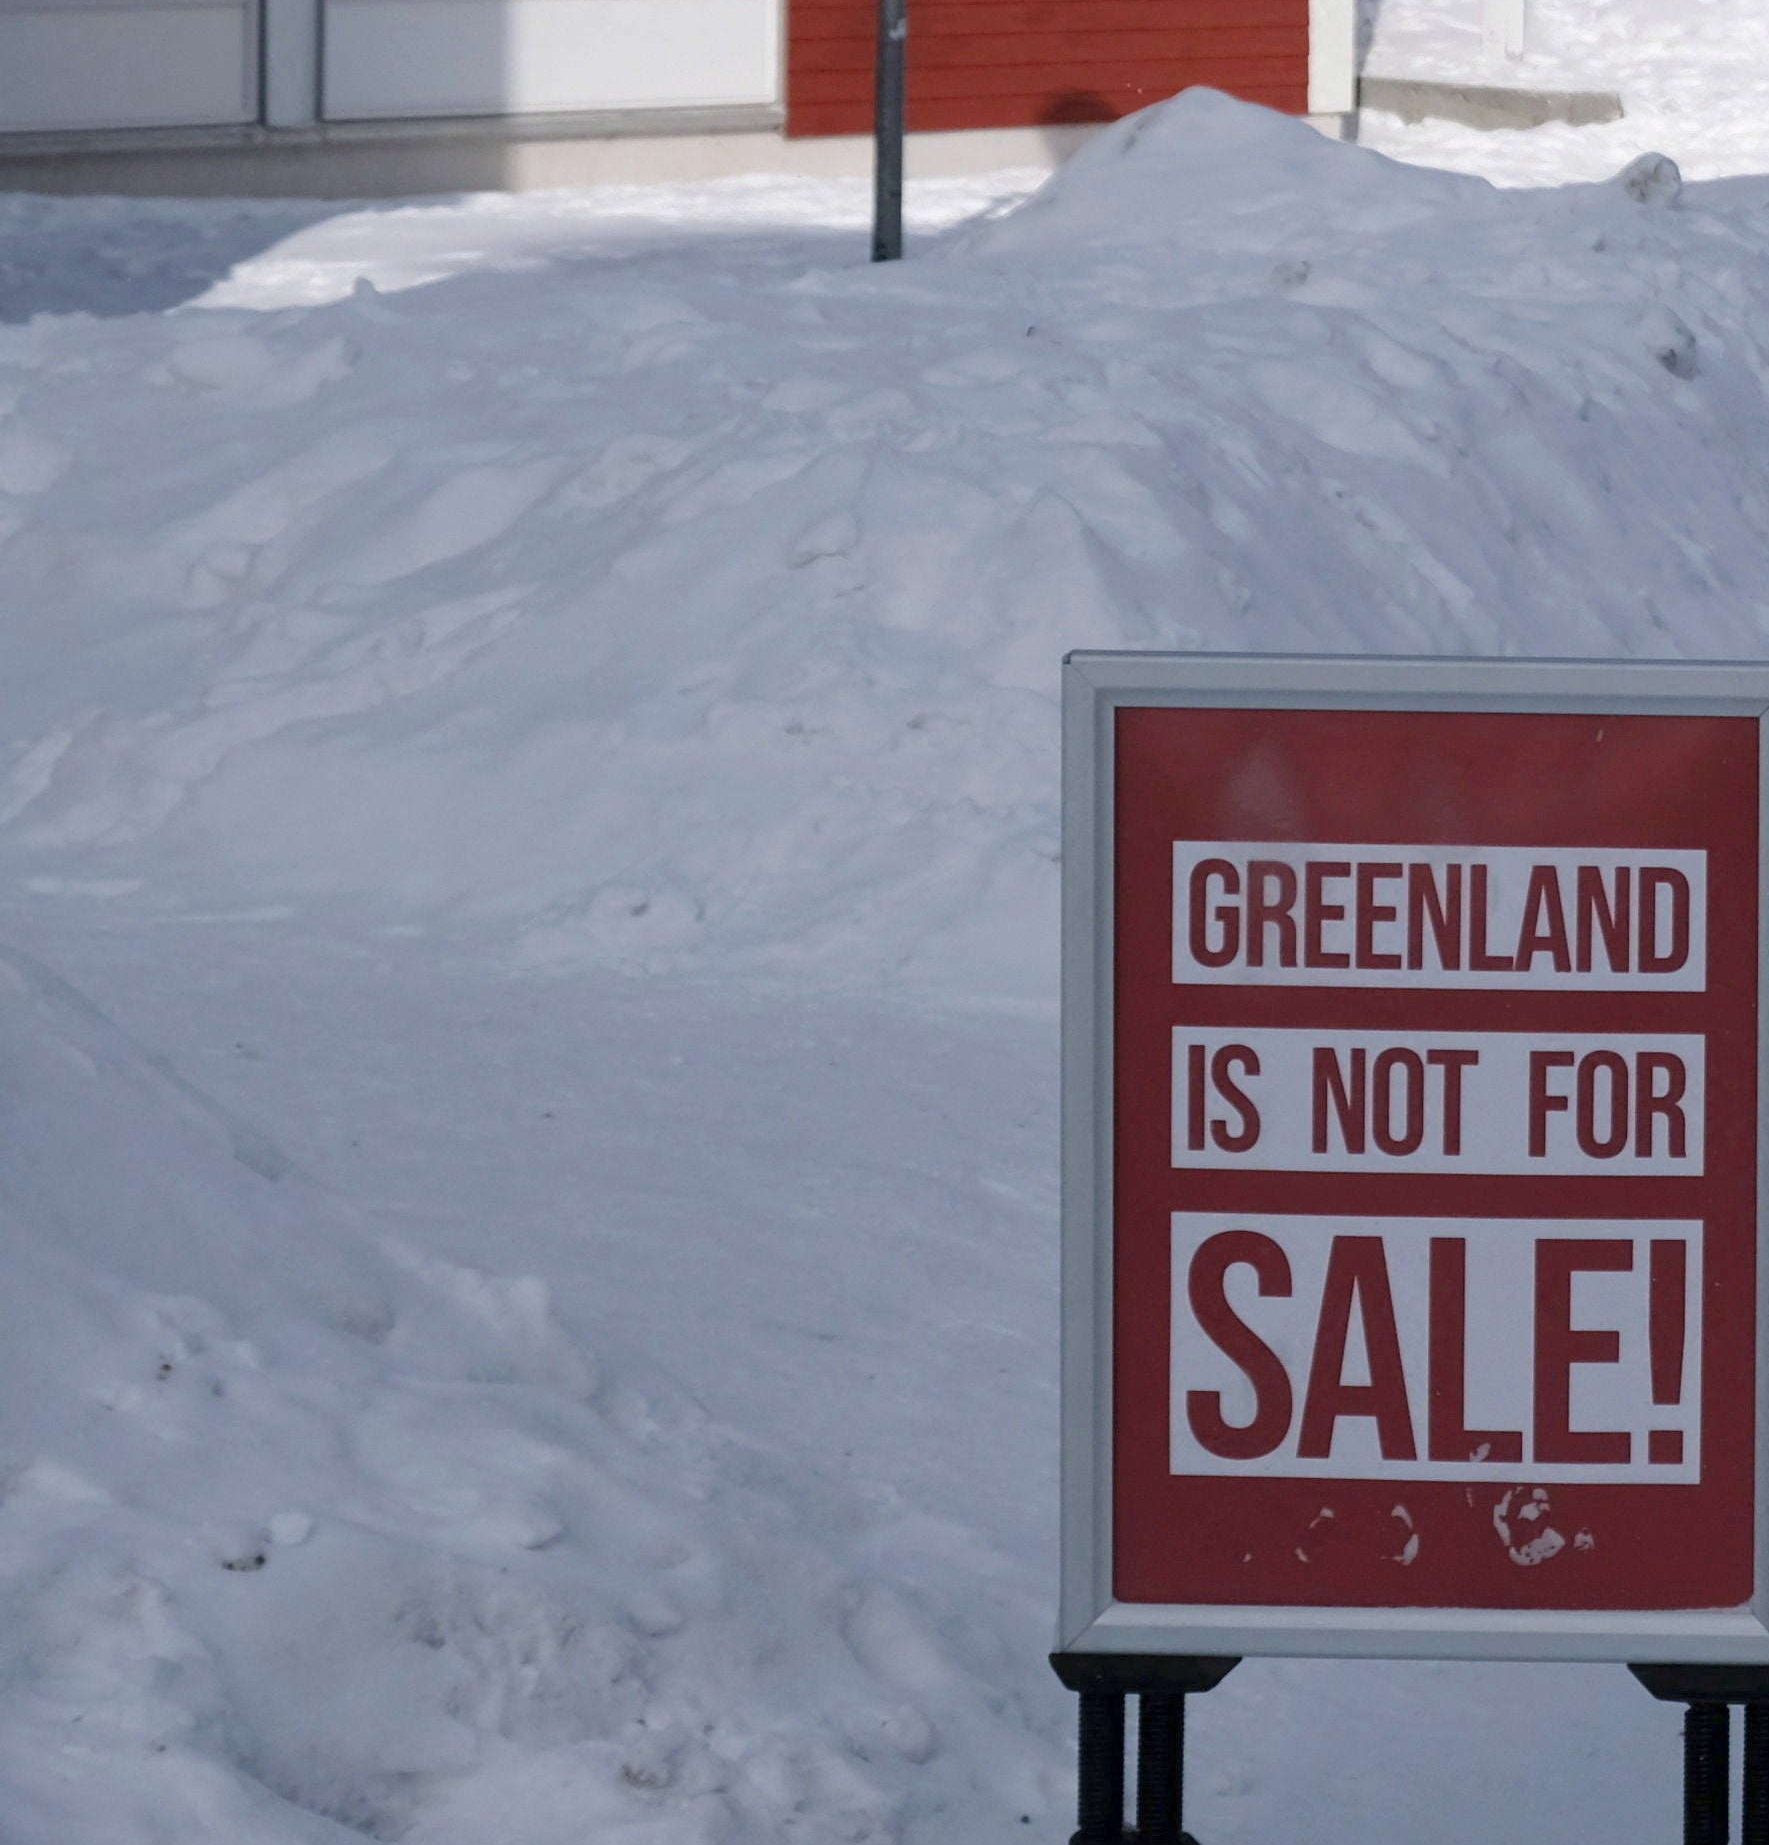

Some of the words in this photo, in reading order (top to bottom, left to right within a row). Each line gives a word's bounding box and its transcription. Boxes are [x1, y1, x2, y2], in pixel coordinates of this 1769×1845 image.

[1187, 858, 1691, 974] GREENLAND
[1187, 1043, 1261, 1153] IS
[1312, 1046, 1479, 1157] NOT
[1528, 1050, 1687, 1159] FOR
[1186, 1230, 1687, 1466] SALE!
